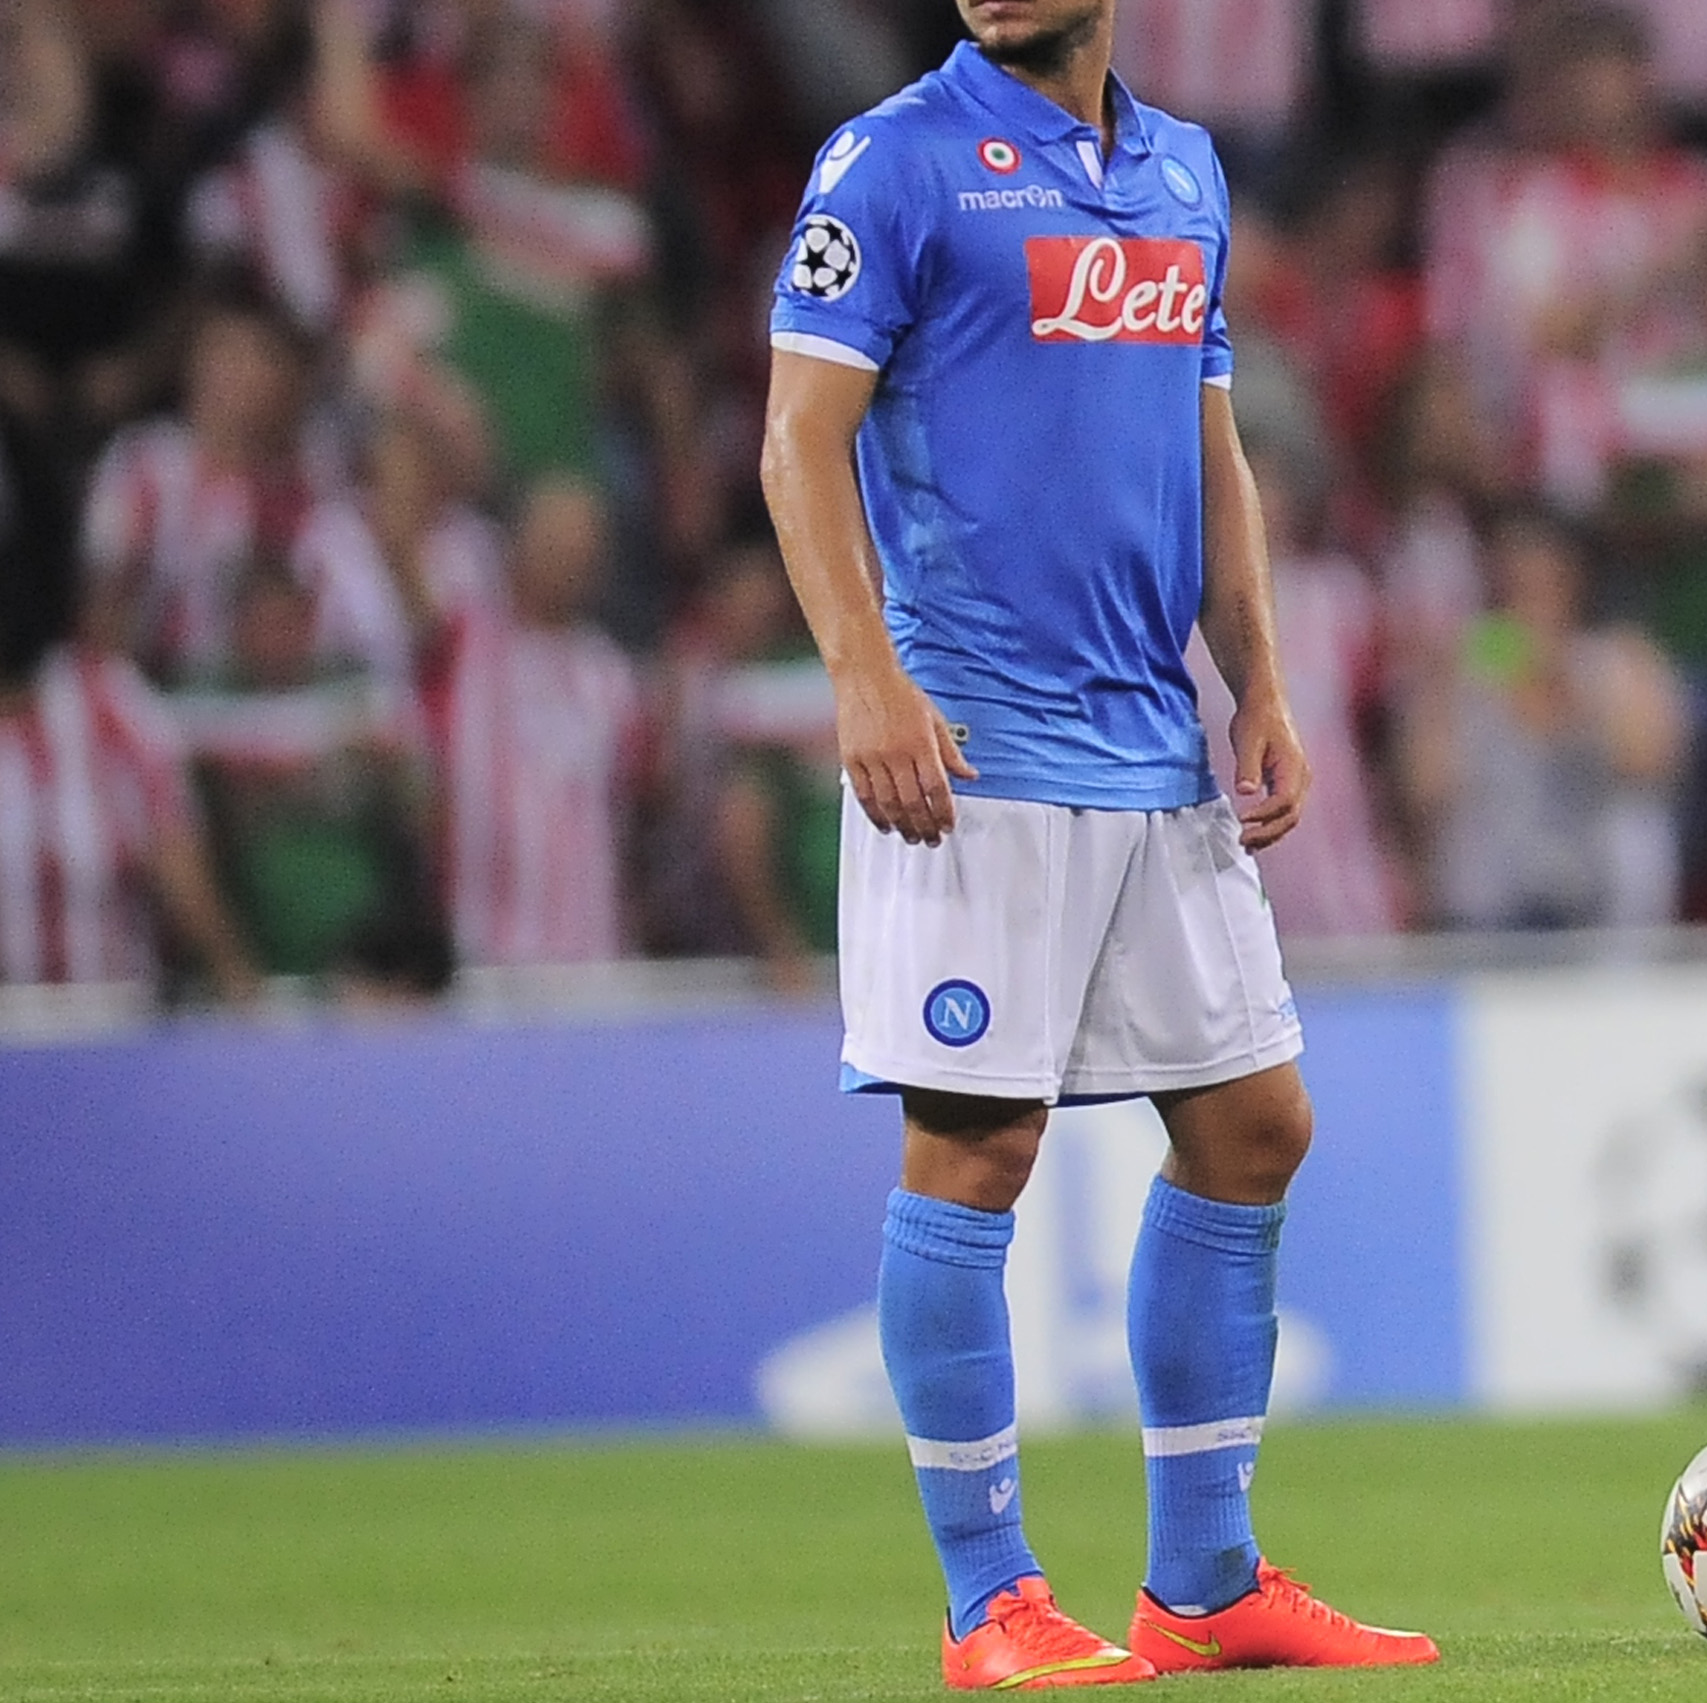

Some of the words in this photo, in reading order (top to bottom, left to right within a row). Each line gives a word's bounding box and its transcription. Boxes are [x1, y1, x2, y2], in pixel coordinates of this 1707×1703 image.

[958, 184, 1063, 211] macron
[1032, 237, 1206, 341] Lete
[939, 996, 972, 1030] N
